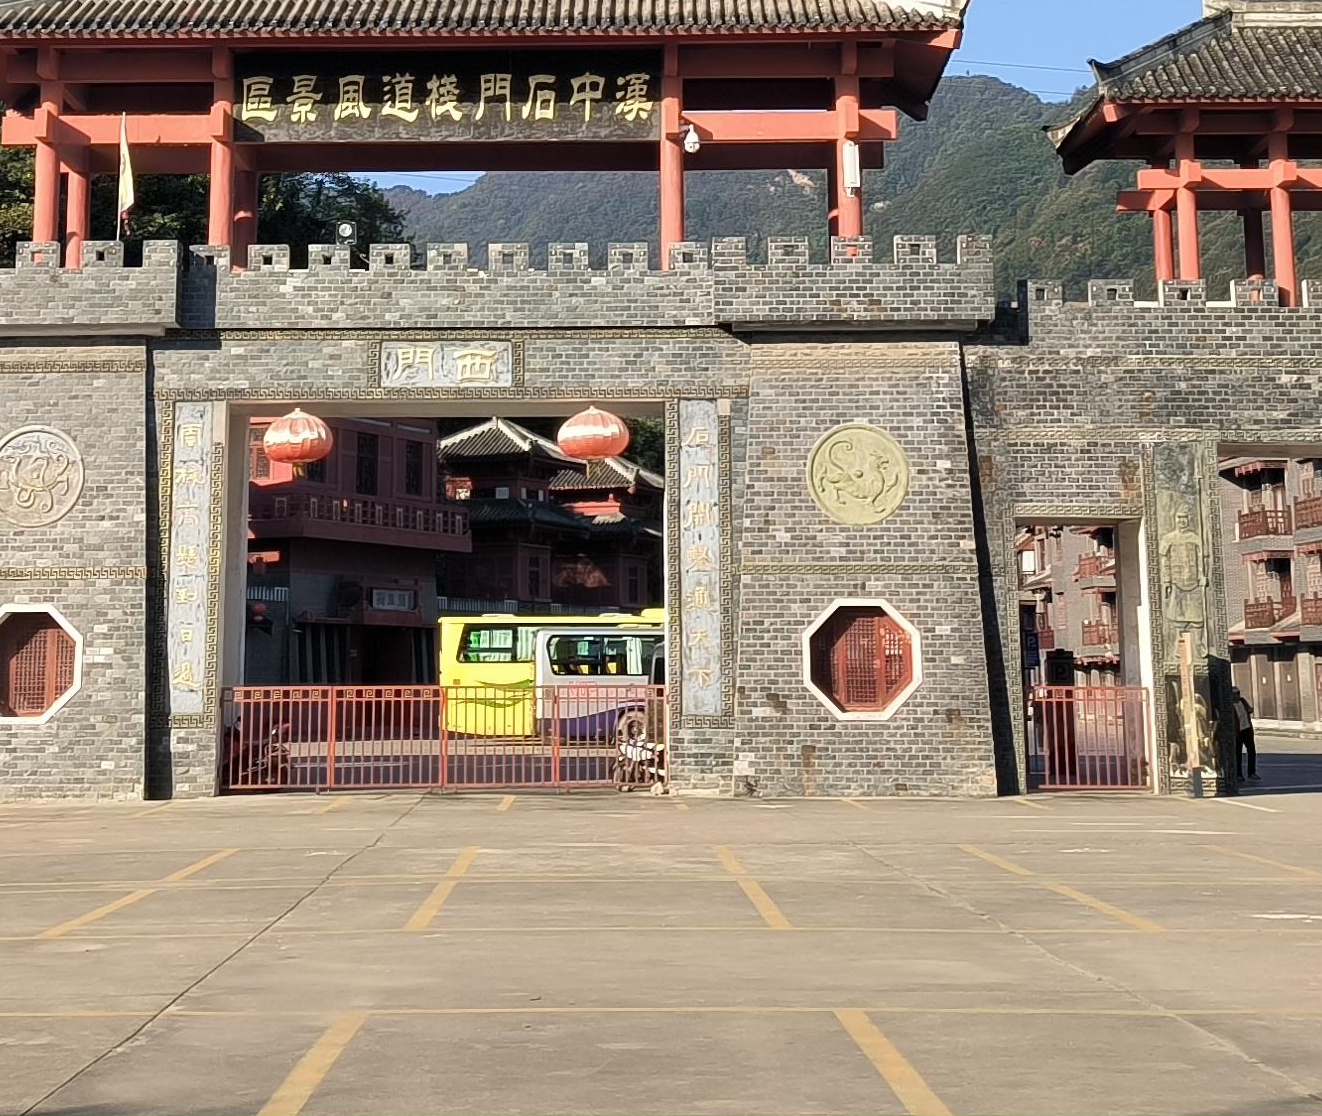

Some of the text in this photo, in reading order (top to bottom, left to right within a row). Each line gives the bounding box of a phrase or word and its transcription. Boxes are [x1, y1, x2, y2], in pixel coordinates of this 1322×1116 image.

[240, 71, 654, 124] 漢中石門棧道風景區
